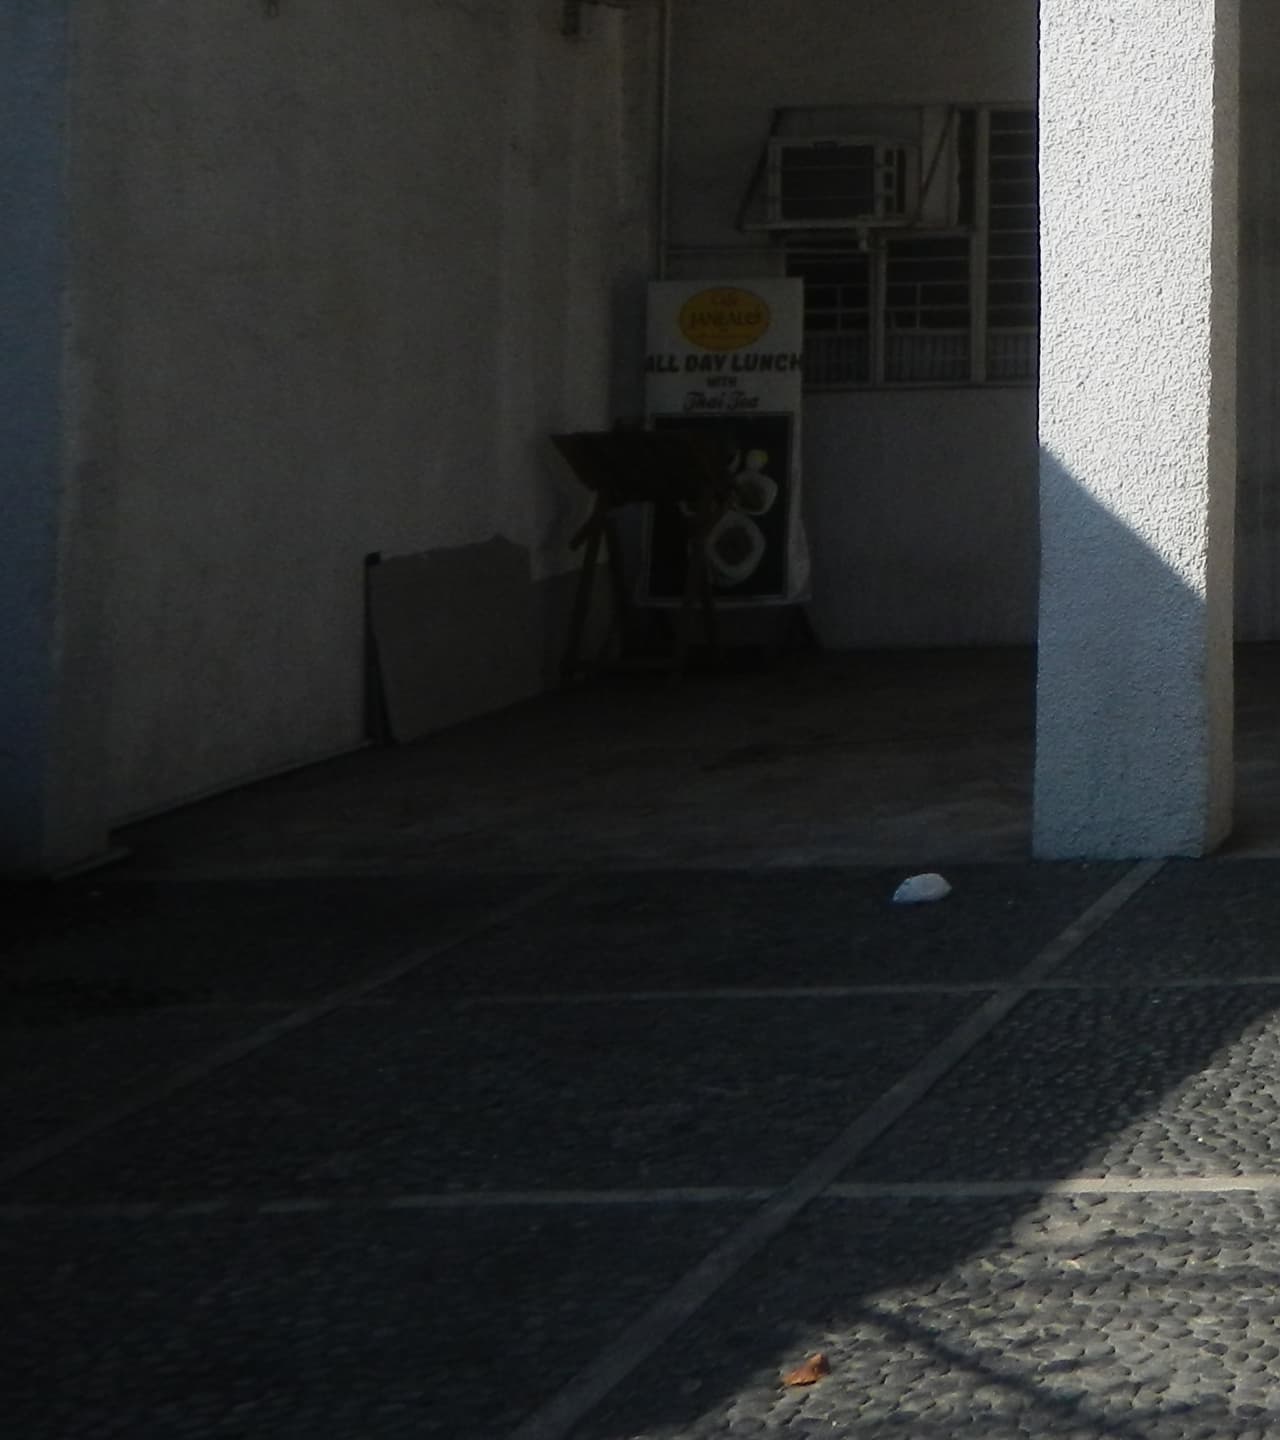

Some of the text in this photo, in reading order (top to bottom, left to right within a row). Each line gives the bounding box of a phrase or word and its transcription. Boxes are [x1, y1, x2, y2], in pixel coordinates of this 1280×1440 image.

[645, 353, 802, 372] ALL DAY LUNCH
